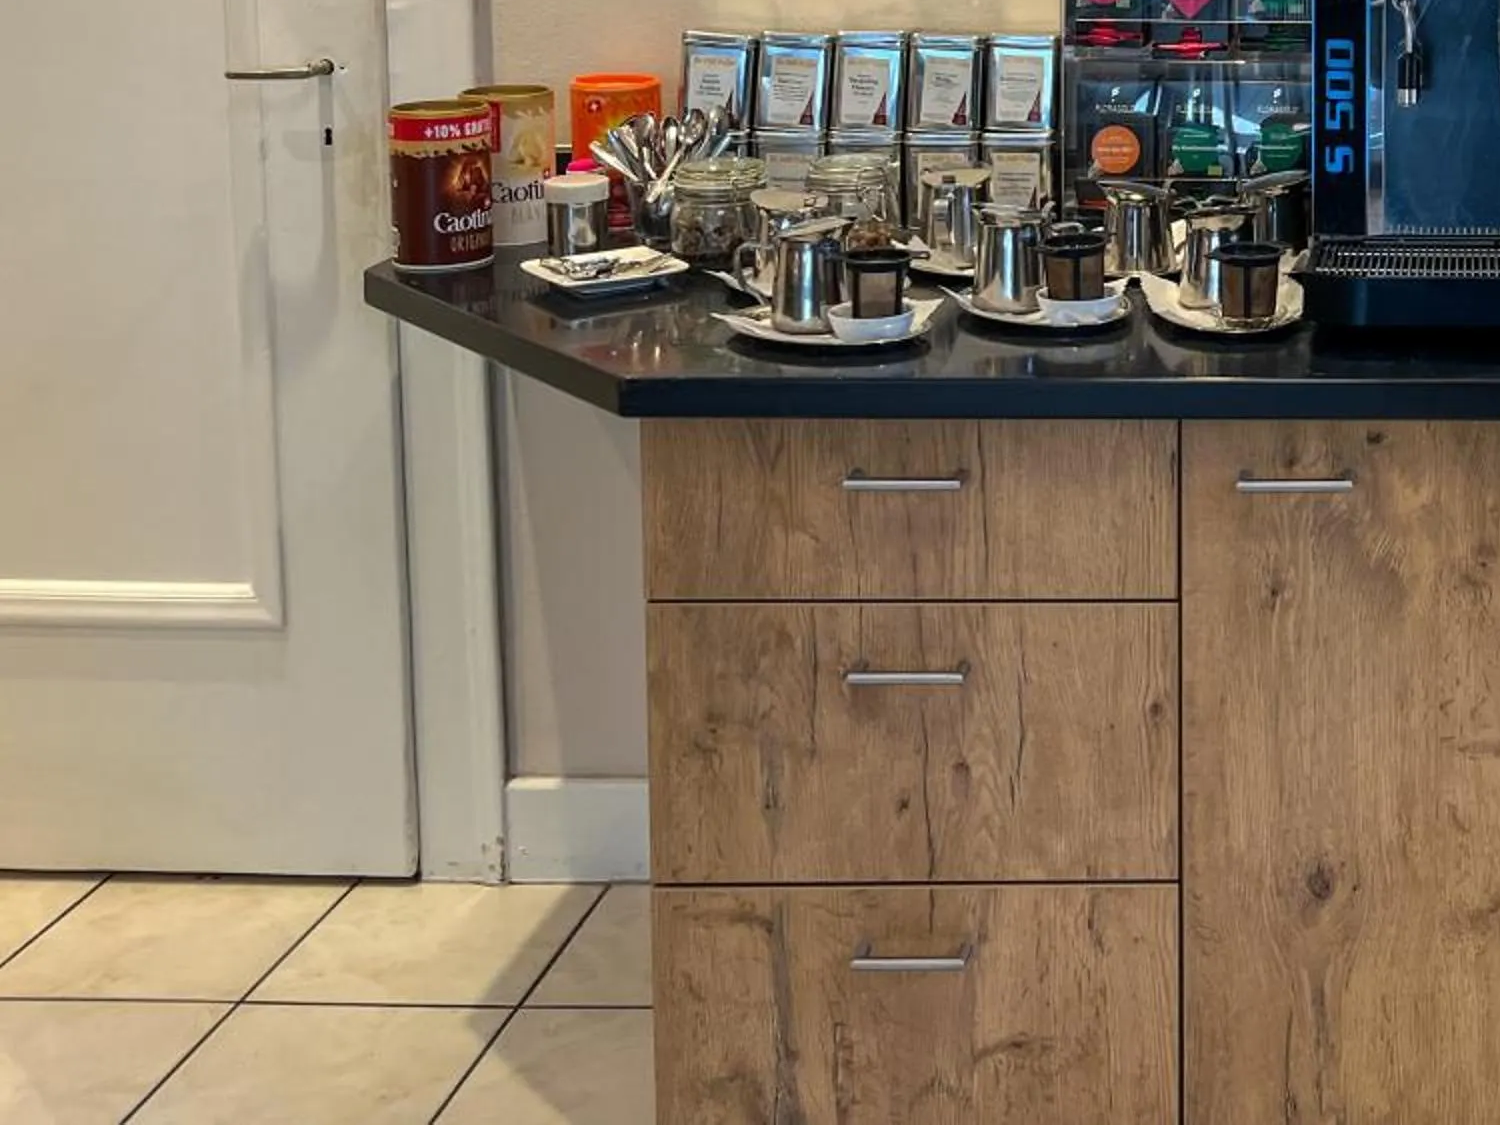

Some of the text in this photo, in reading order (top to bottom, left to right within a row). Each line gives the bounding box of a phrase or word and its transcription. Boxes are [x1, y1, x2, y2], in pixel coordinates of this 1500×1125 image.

[424, 123, 462, 139] +10%
[1324, 38, 1355, 173] S 500
